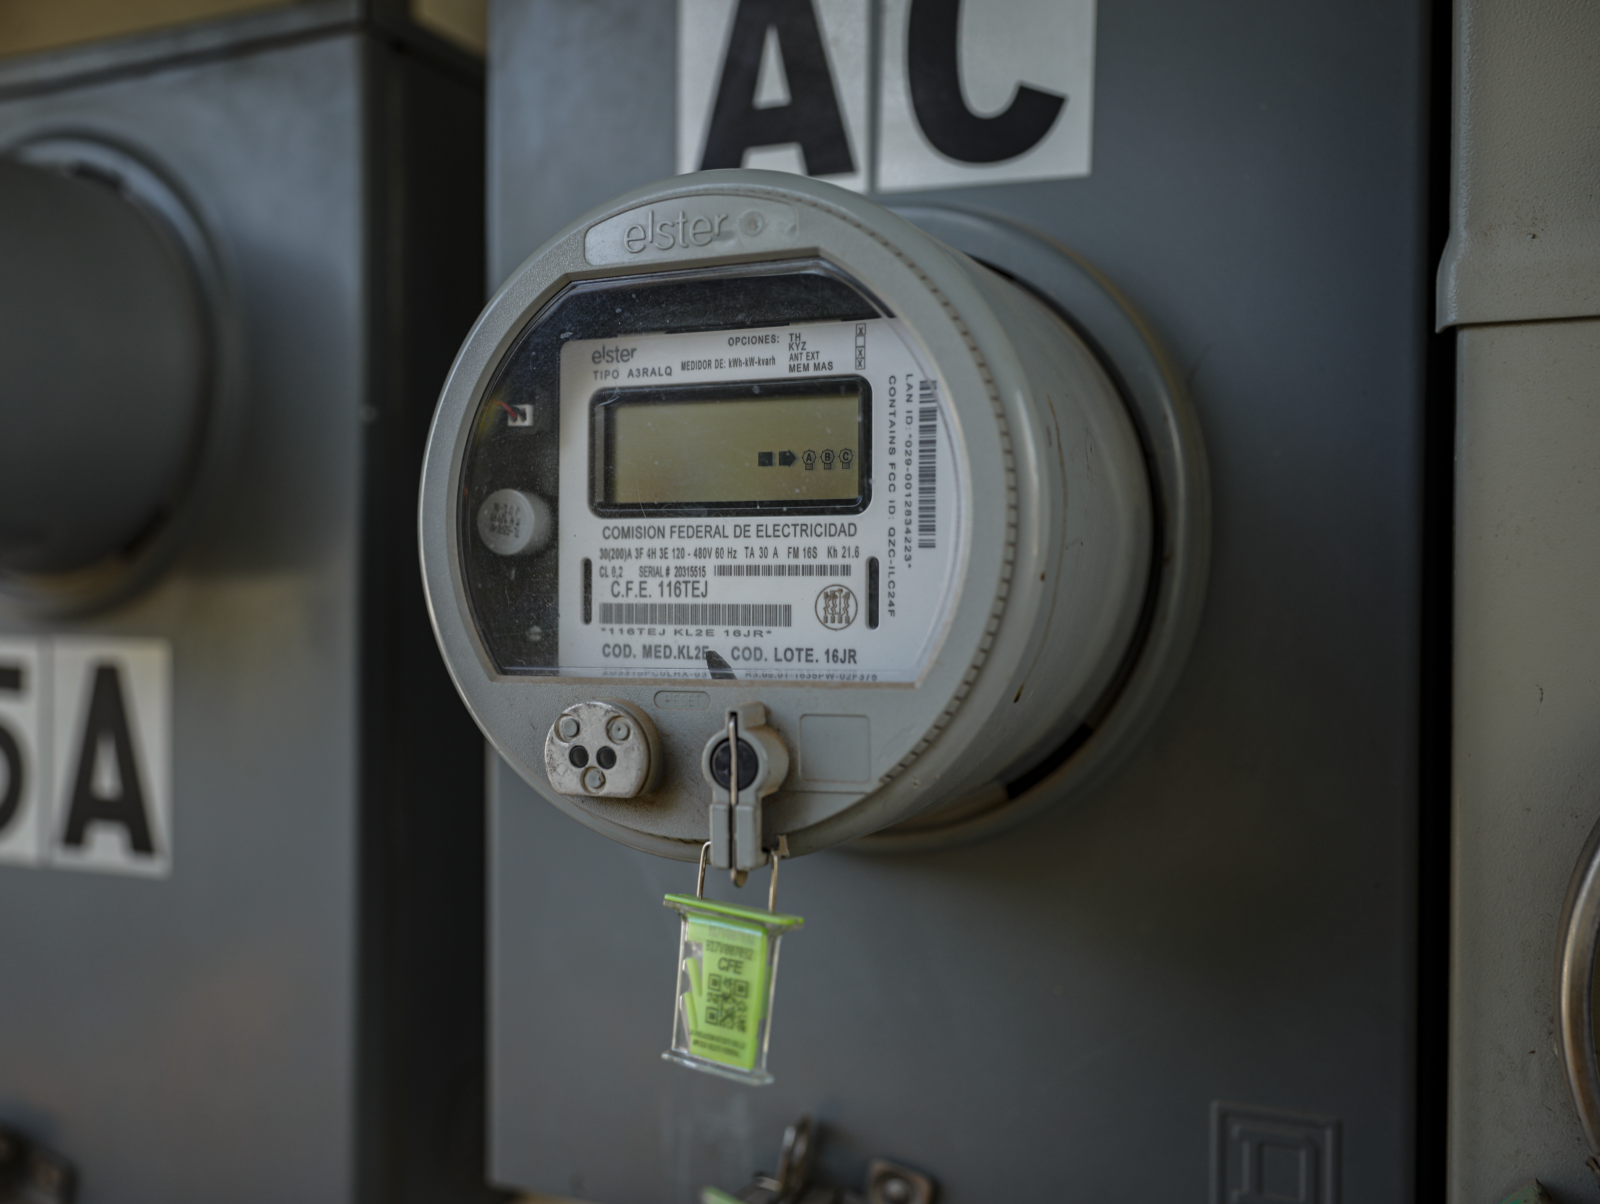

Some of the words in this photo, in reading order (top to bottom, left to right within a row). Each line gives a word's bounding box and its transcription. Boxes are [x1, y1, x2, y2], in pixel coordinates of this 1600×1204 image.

[624, 210, 728, 254] elster
[728, 334, 780, 347] OPCIONES:
[789, 333, 801, 342] TH
[789, 342, 806, 352] KYZ
[591, 344, 637, 365] elster
[789, 353, 803, 362] ANT
[806, 351, 820, 361] EXT
[593, 369, 619, 380] TIPO
[627, 366, 673, 378] A3RALQ
[681, 359, 712, 371] MEDIDOR
[714, 359, 726, 369] DE:
[789, 363, 810, 373] MEM
[813, 361, 834, 371] MAS
[905, 374, 913, 403] LAN
[888, 375, 897, 456] CONTAINS
[905, 410, 913, 430] ID:
[888, 462, 896, 493] FCC
[888, 500, 896, 520] ID:
[602, 525, 666, 540] COMISION
[670, 524, 729, 539] FEDERAL
[733, 524, 751, 538] DE
[756, 522, 857, 538] ELECTRICIDAD
[599, 547, 632, 562] 30(200)A
[635, 547, 644, 560] 3F
[647, 547, 656, 560] 4H
[659, 547, 669, 560] 3E
[672, 547, 685, 560] 120
[693, 547, 712, 559] 480V
[715, 547, 725, 559] 60
[727, 546, 737, 559] Hz
[744, 546, 755, 559] TA
[759, 546, 768, 559] 30
[772, 546, 779, 559] A
[788, 546, 799, 559] FM
[803, 546, 818, 559] 16S
[827, 545, 838, 559] Kh
[842, 545, 860, 559] 21.6
[600, 566, 609, 578] CL
[639, 566, 664, 578] SERIAL
[674, 566, 706, 578] 20315515
[611, 580, 652, 598] C.F.E.
[658, 580, 708, 598] 116TEJ
[674, 628, 715, 637] KL2E
[602, 643, 637, 659] COD.
[731, 646, 768, 662] COD.
[774, 647, 819, 663] LOTE.
[824, 648, 857, 664] 16JR
[718, 957, 744, 975] CFE
